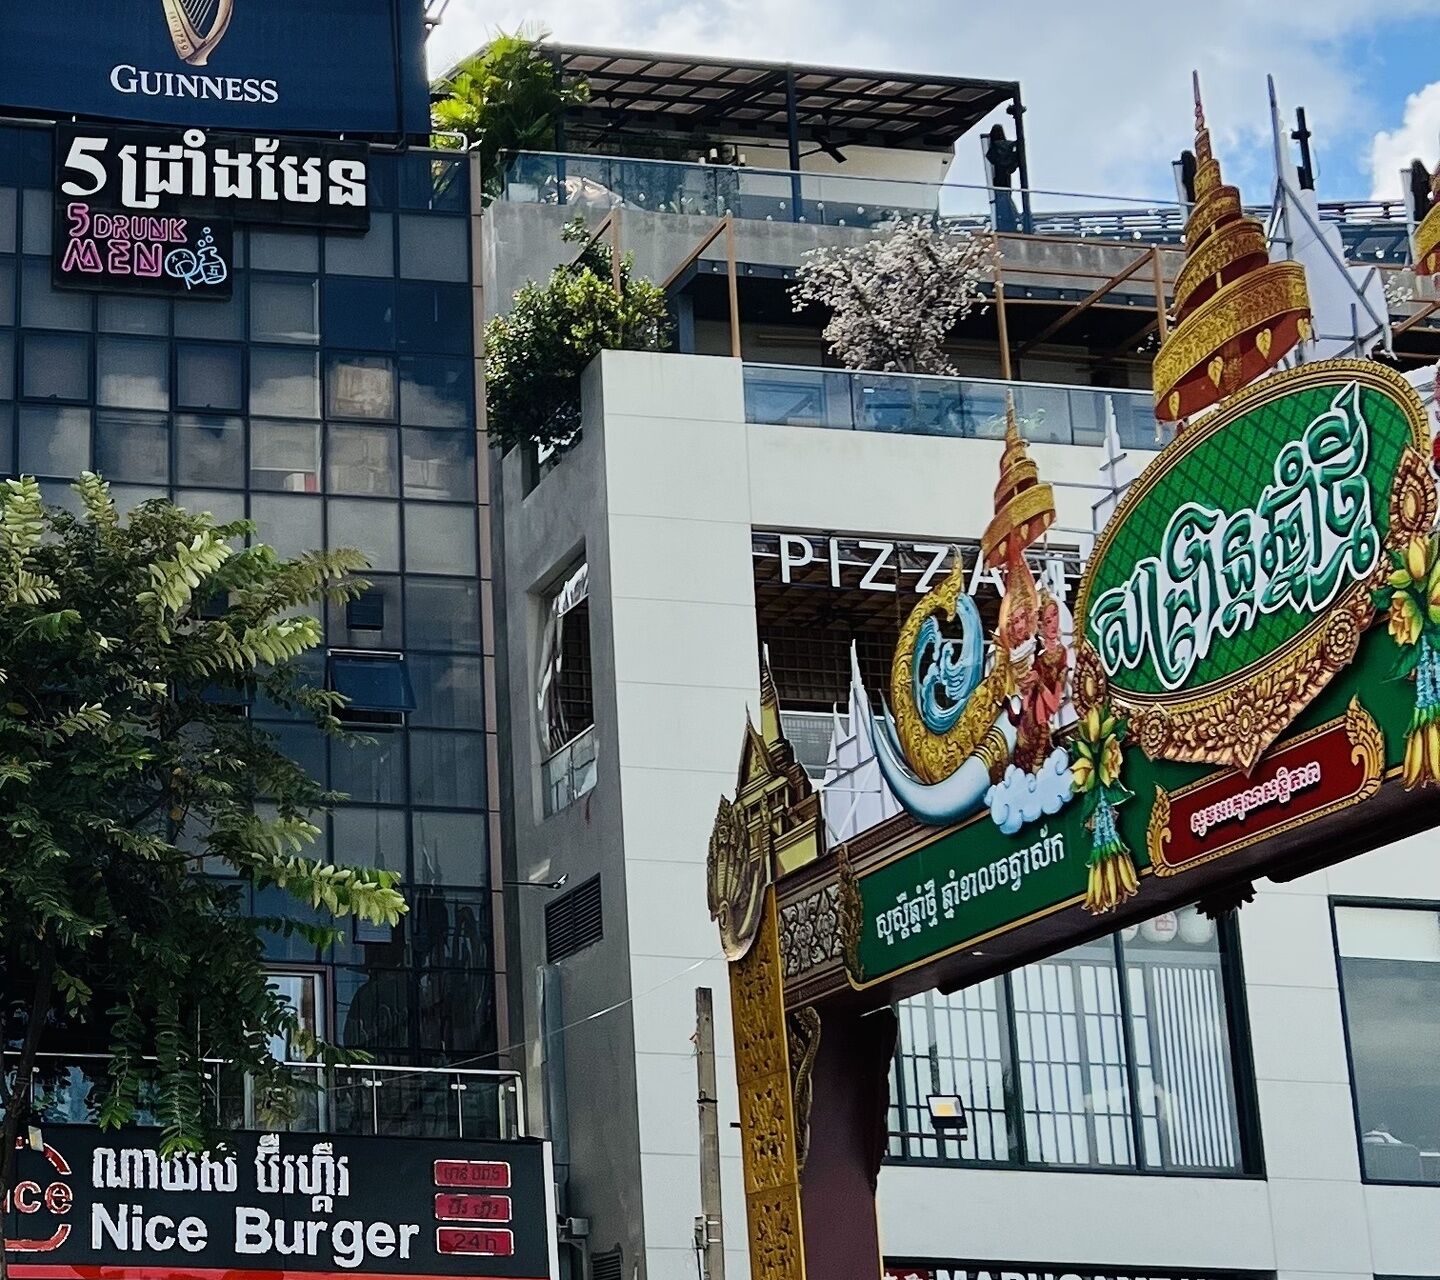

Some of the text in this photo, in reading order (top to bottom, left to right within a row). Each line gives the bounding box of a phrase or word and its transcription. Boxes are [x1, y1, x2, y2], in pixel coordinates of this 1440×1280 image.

[110, 64, 279, 104] GUINNESS
[66, 203, 188, 243] 5 DRUNK
[62, 238, 162, 277] MEN
[779, 534, 1006, 598] PIZZA
[91, 1202, 420, 1268] Nice Burger
[454, 1232, 497, 1251] 24h
